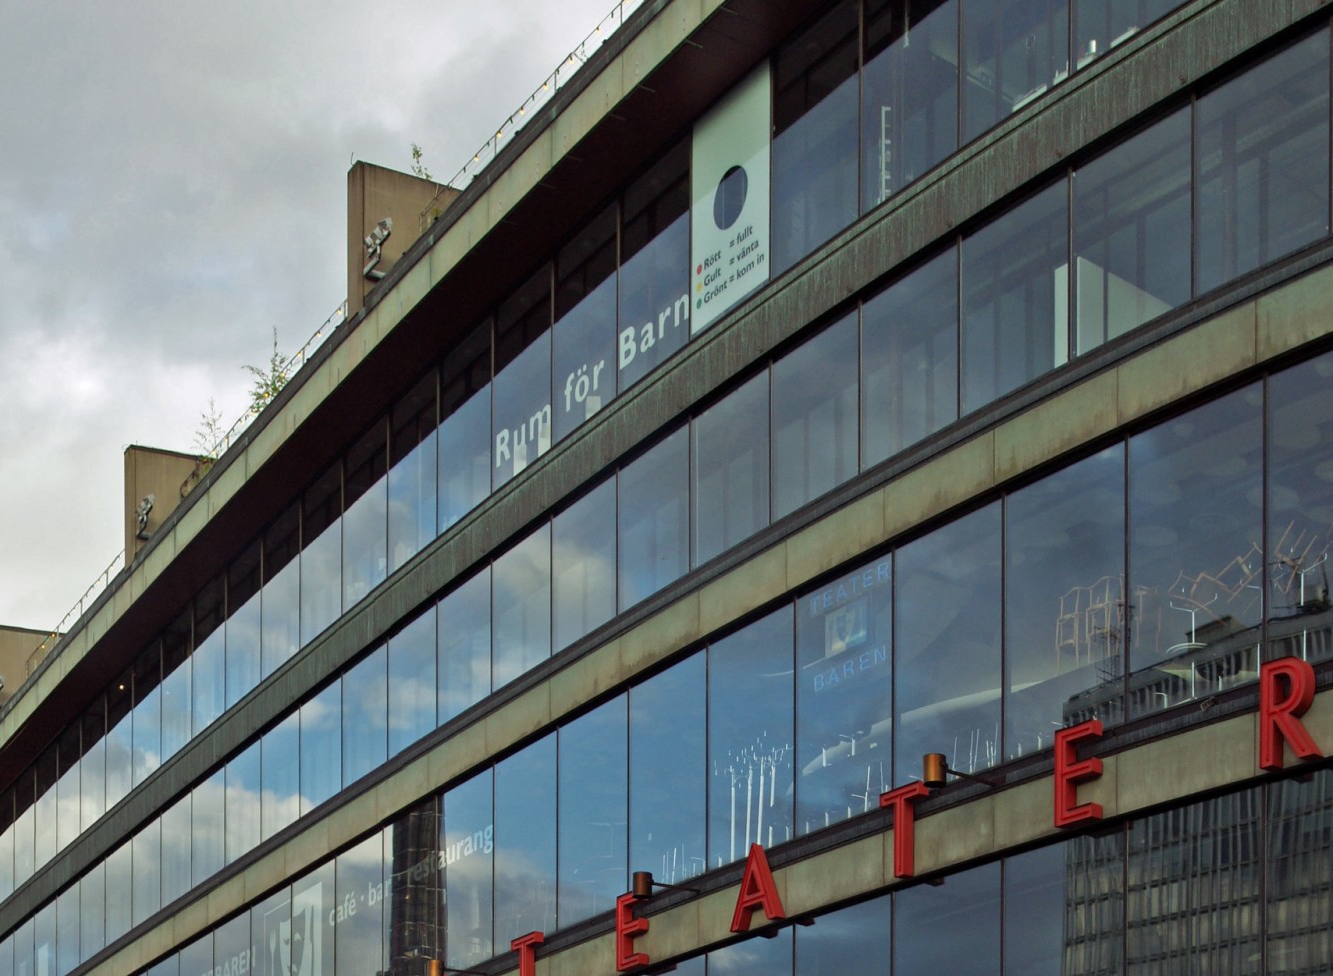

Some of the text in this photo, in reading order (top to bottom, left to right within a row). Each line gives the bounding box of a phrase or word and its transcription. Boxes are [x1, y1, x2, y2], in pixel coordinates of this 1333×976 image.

[704, 250, 721, 270] Rött
[736, 225, 753, 244] fullt
[704, 268, 721, 286] Gult
[737, 240, 759, 262] vänta
[704, 281, 728, 303] Grönt
[737, 261, 755, 279] kom
[756, 253, 765, 265] in
[496, 293, 690, 468] Rum för Barn
[811, 562, 889, 613] TEATER
[814, 645, 886, 692] BAREN
[329, 824, 494, 926] café bar restaurang
